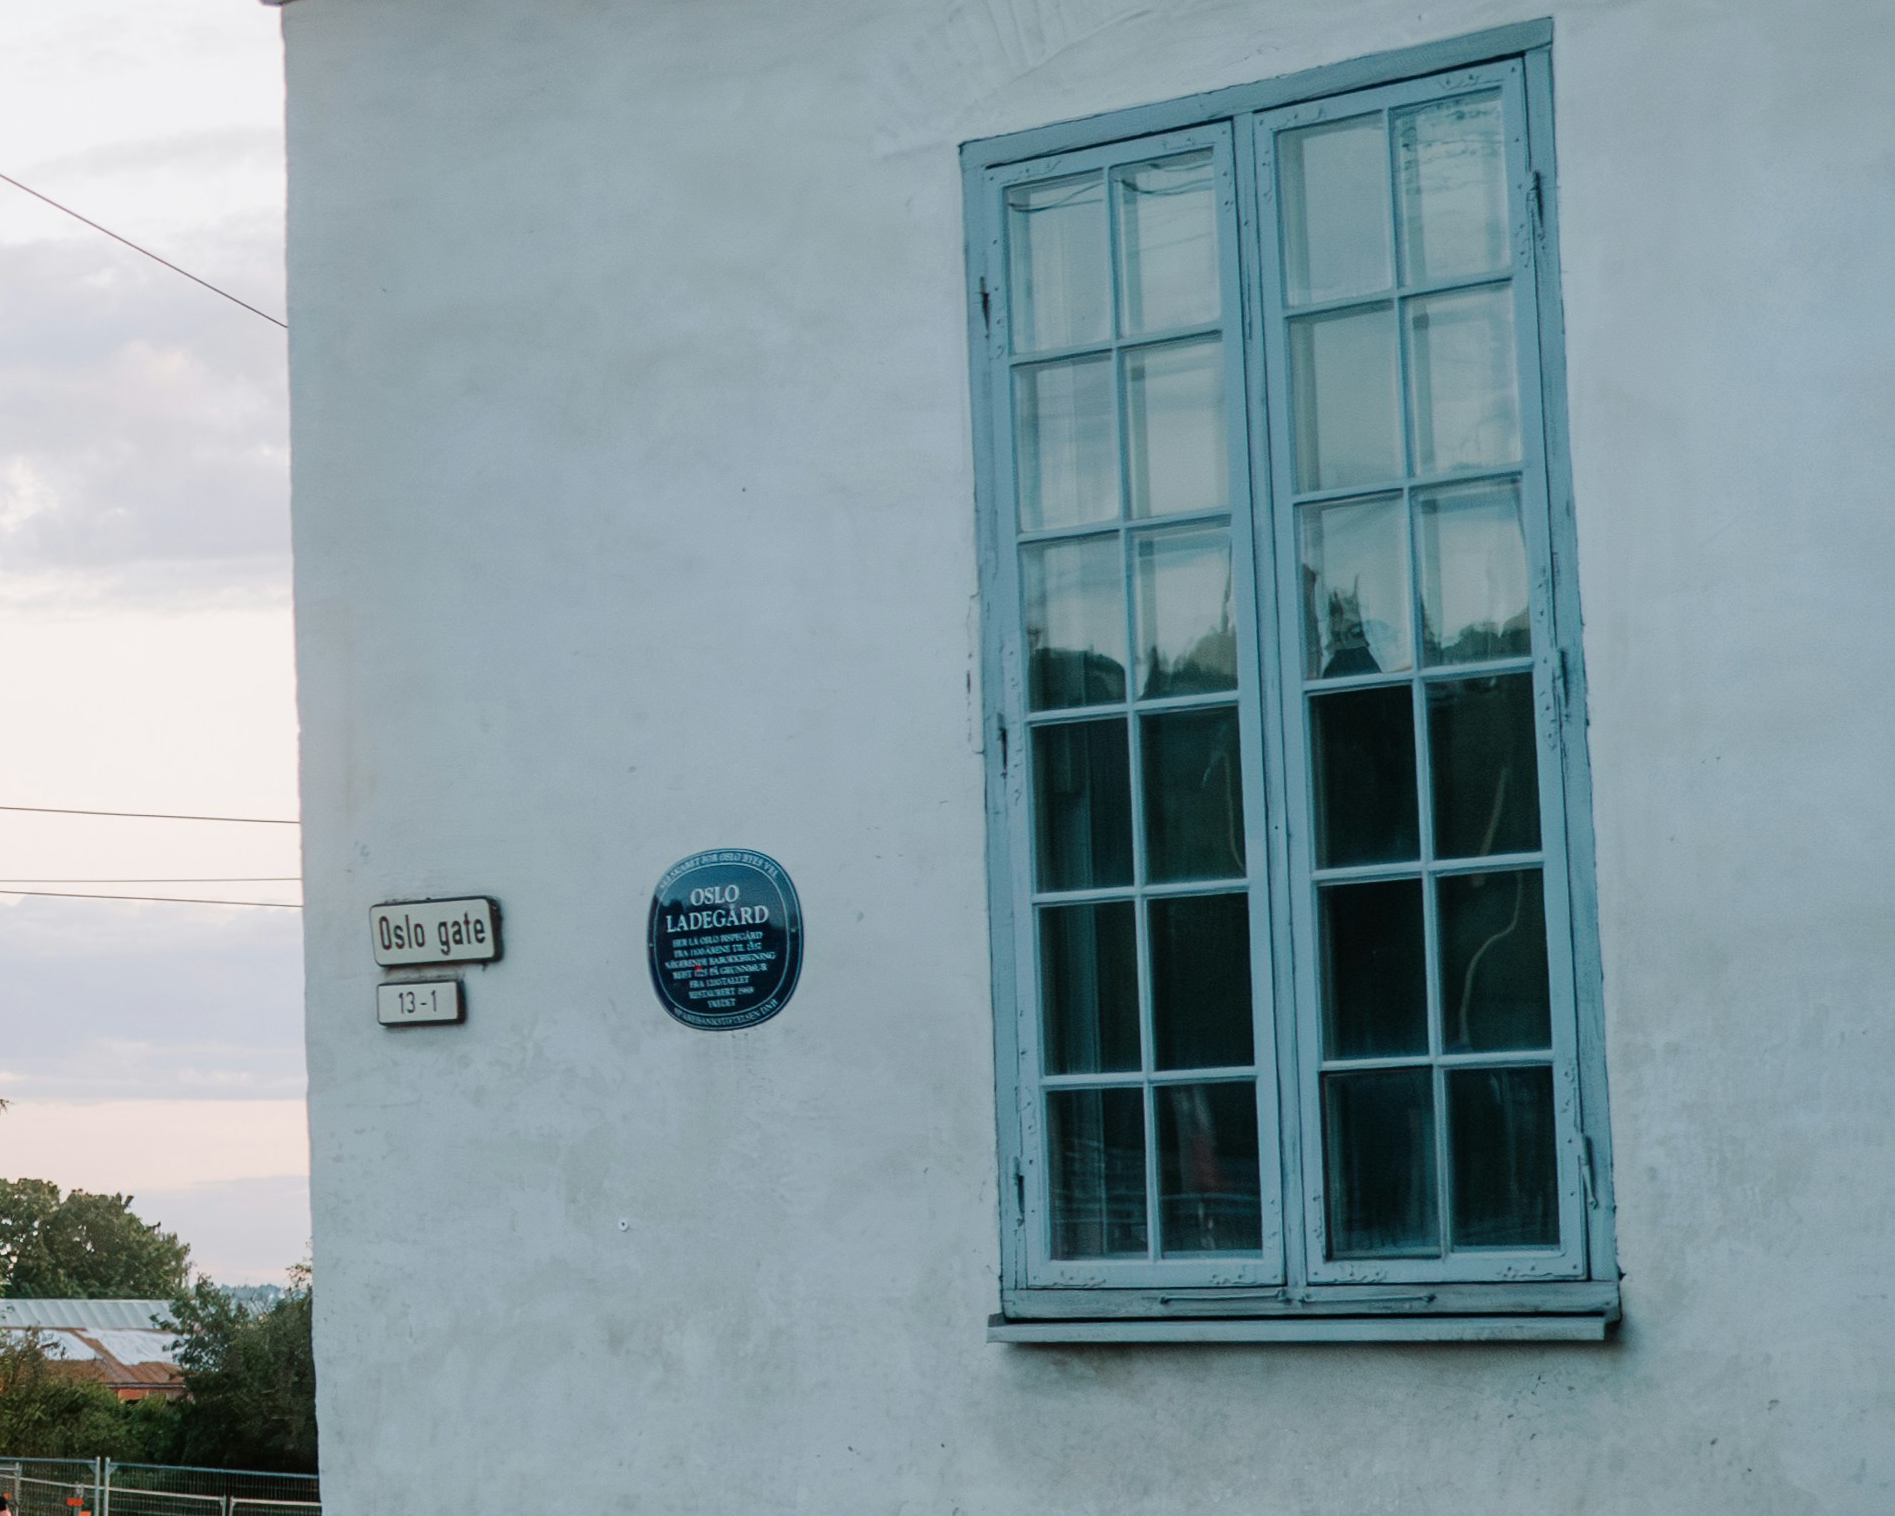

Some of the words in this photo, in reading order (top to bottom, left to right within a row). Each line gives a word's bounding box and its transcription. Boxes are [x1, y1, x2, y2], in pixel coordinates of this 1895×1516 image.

[690, 884, 740, 906] OSLO
[666, 903, 769, 933] LADEGÅRD
[378, 914, 426, 950] Oslo
[437, 911, 486, 956] gate
